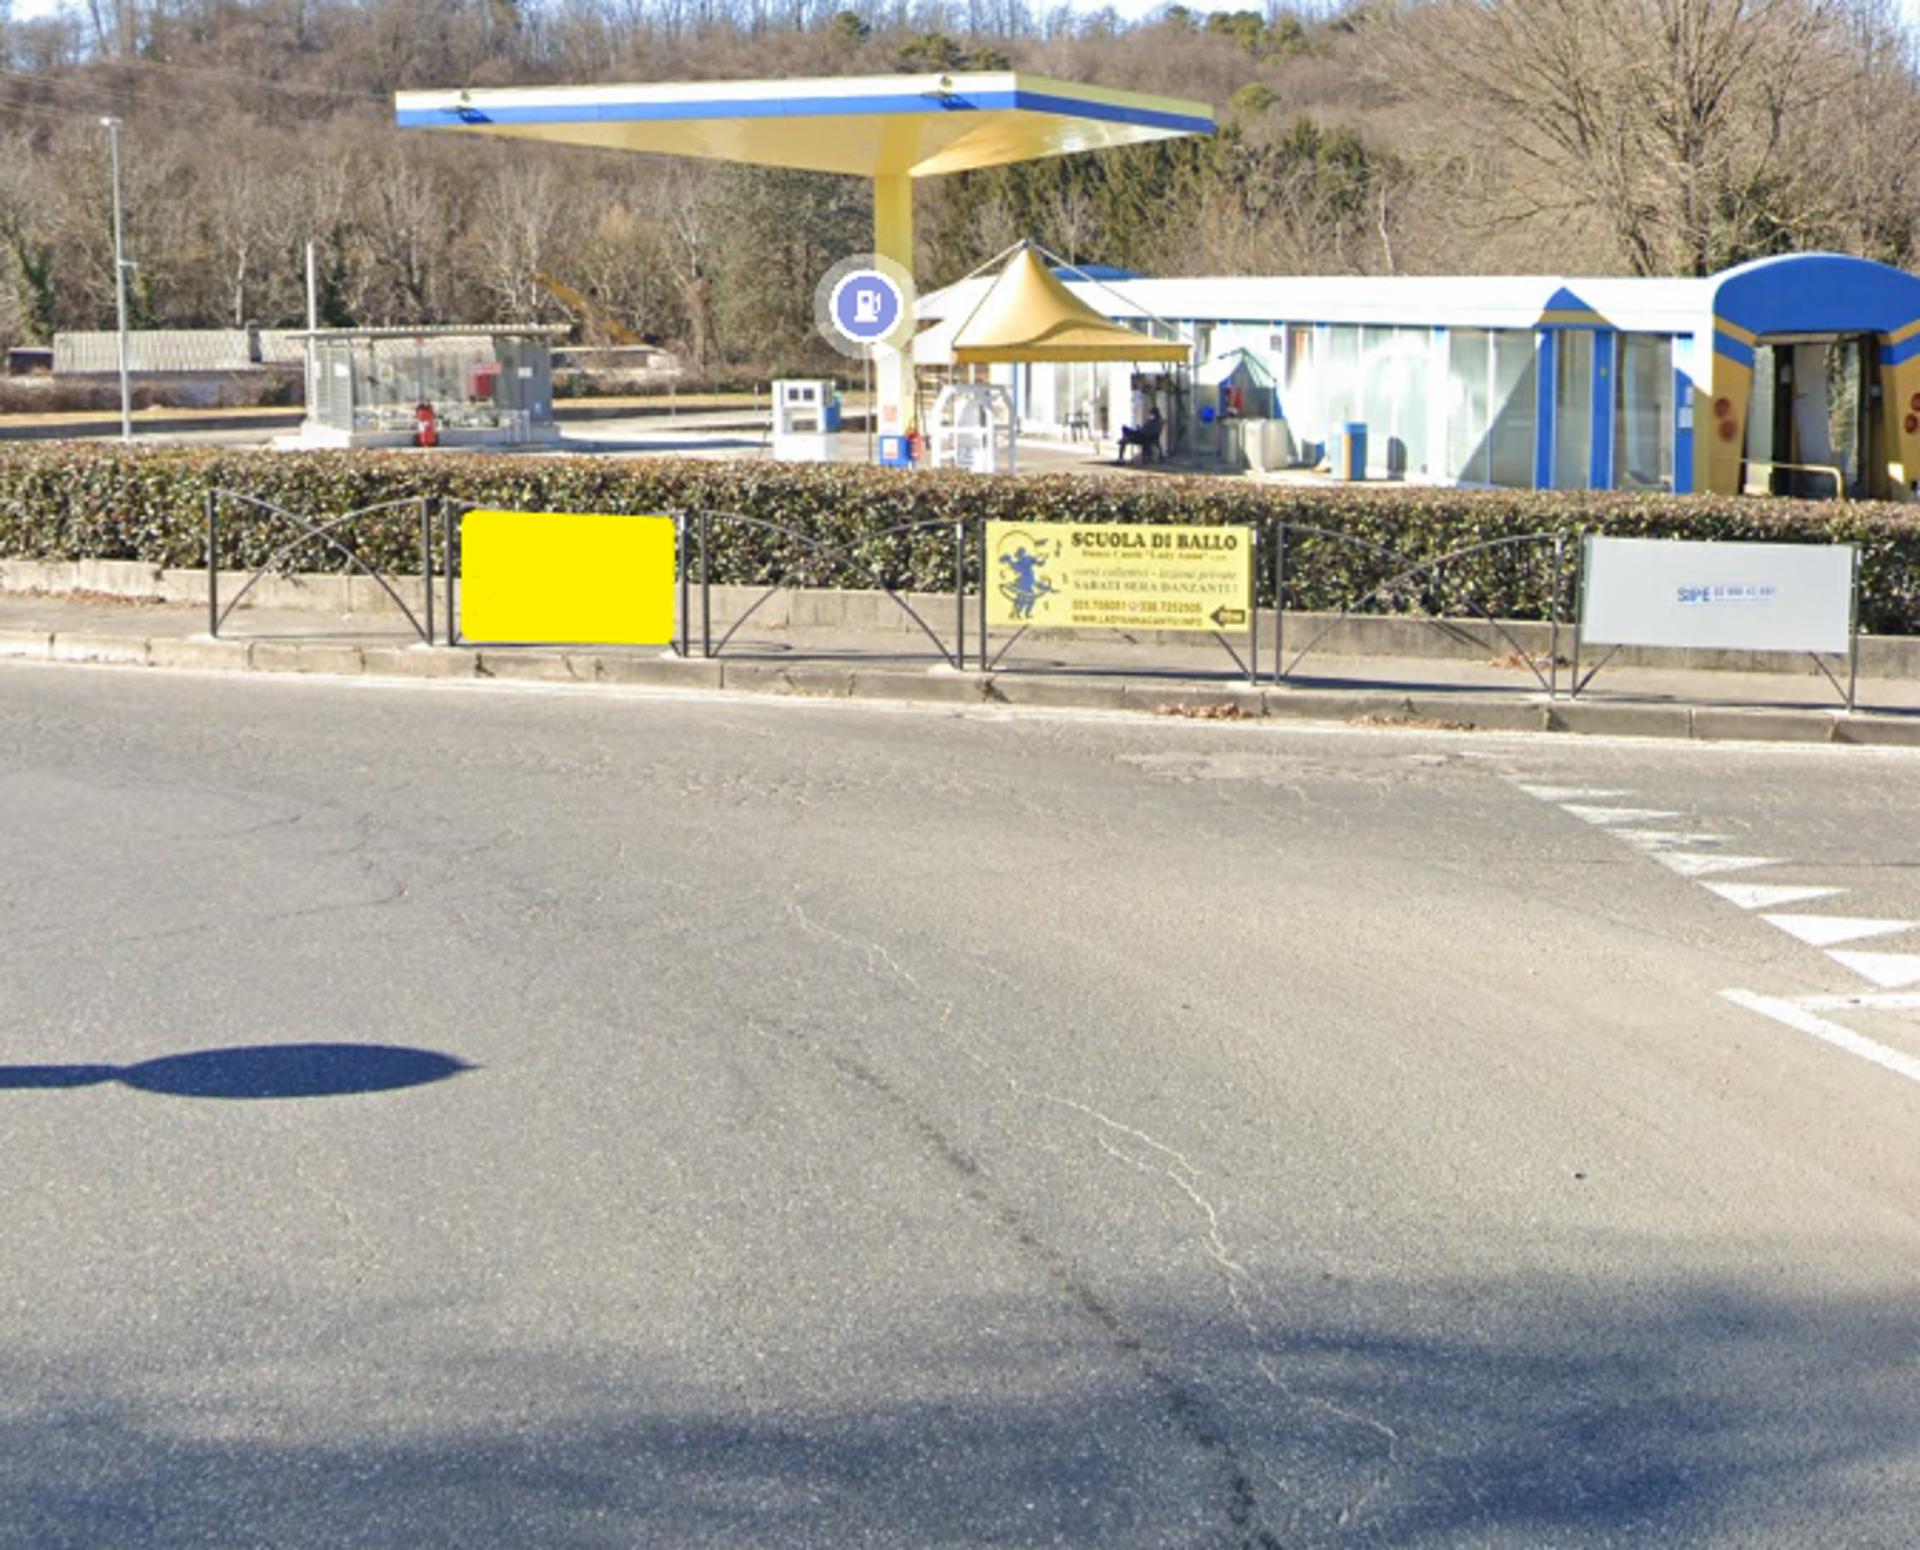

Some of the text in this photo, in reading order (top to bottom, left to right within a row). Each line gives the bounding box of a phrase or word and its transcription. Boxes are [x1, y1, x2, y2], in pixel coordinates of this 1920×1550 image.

[1071, 531, 1238, 551] SCUOLA DI BALLO
[1124, 581, 1157, 592] SERA
